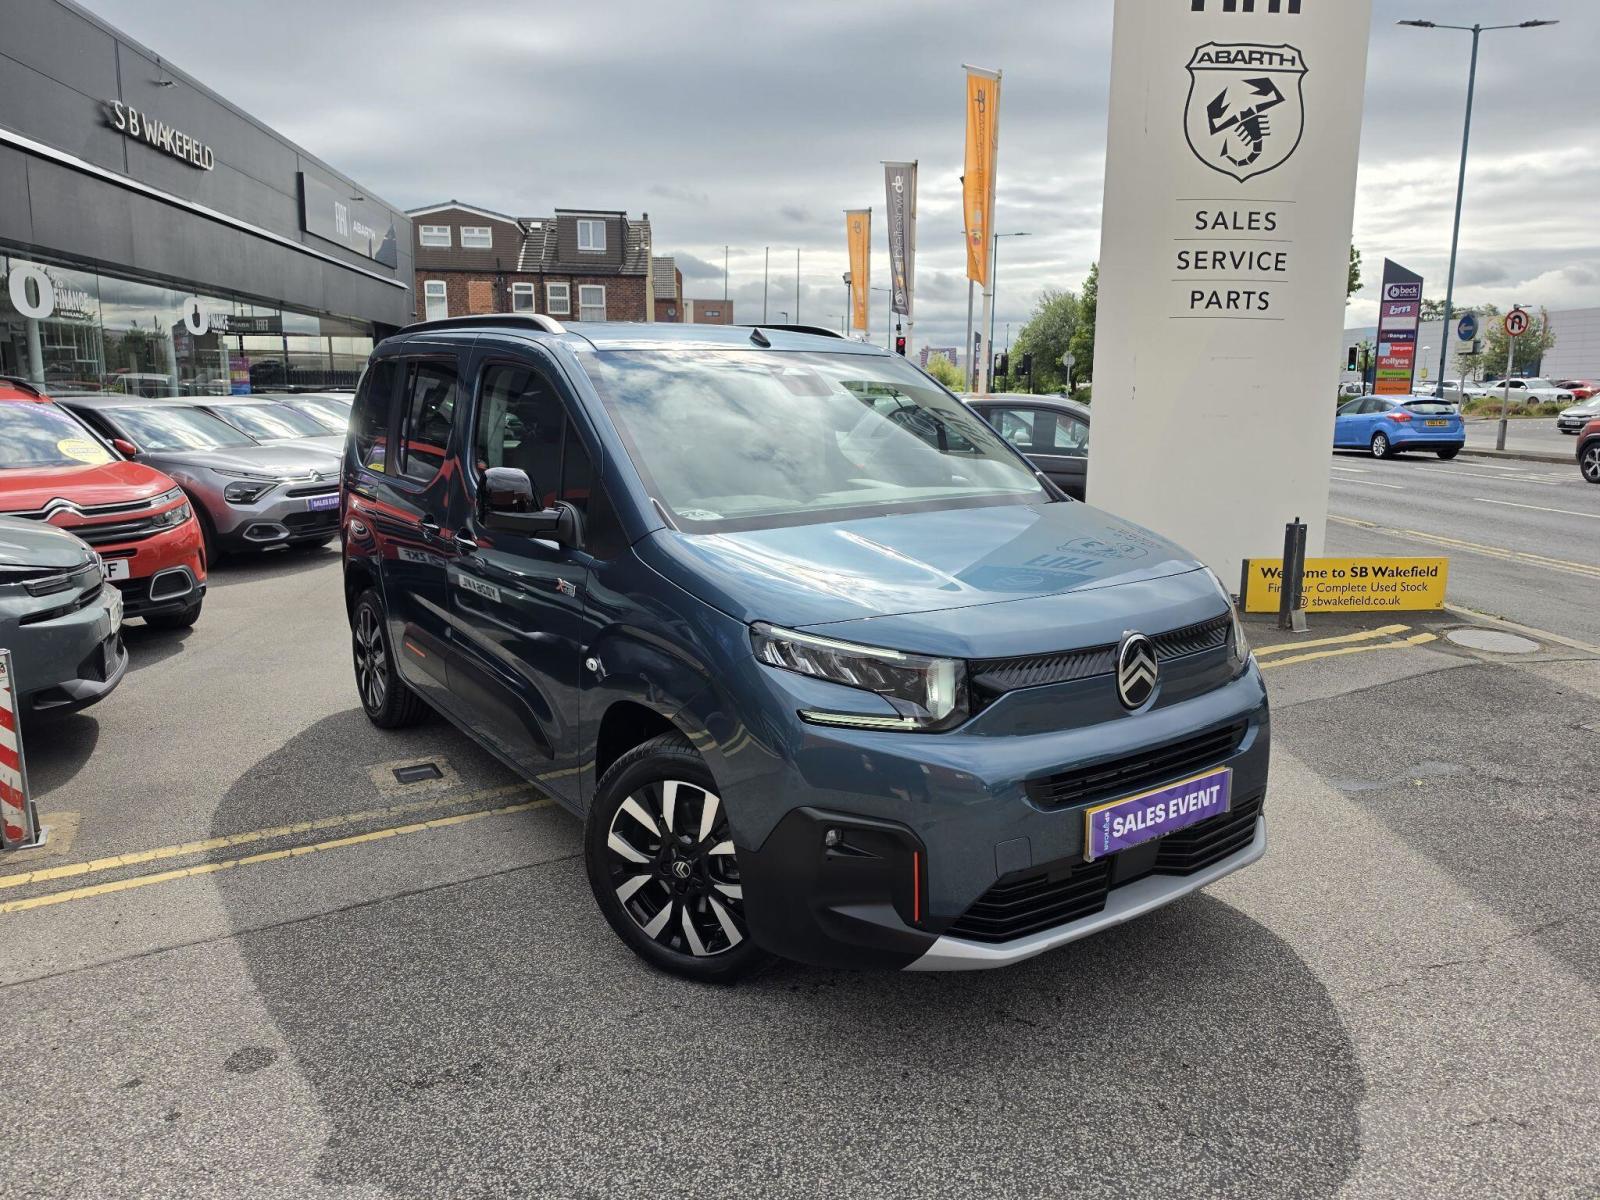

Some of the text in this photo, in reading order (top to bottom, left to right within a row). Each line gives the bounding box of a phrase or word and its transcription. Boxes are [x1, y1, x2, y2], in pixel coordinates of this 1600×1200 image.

[1196, 50, 1296, 67] ABARTH
[141, 112, 215, 171] WAKEFIELD
[1194, 211, 1277, 231] SALES
[1176, 250, 1287, 271] SERVICE
[1189, 290, 1270, 311] PARTS
[1332, 568, 1345, 578] to
[1350, 566, 1369, 578] SB
[1372, 565, 1438, 578] Wakefield
[1316, 582, 1367, 595] Complete
[1371, 582, 1397, 592] Used
[1400, 581, 1428, 592] Stock
[1312, 595, 1400, 606] sbwakefield.co.uk
[1112, 784, 1221, 838] SALES EVENT
